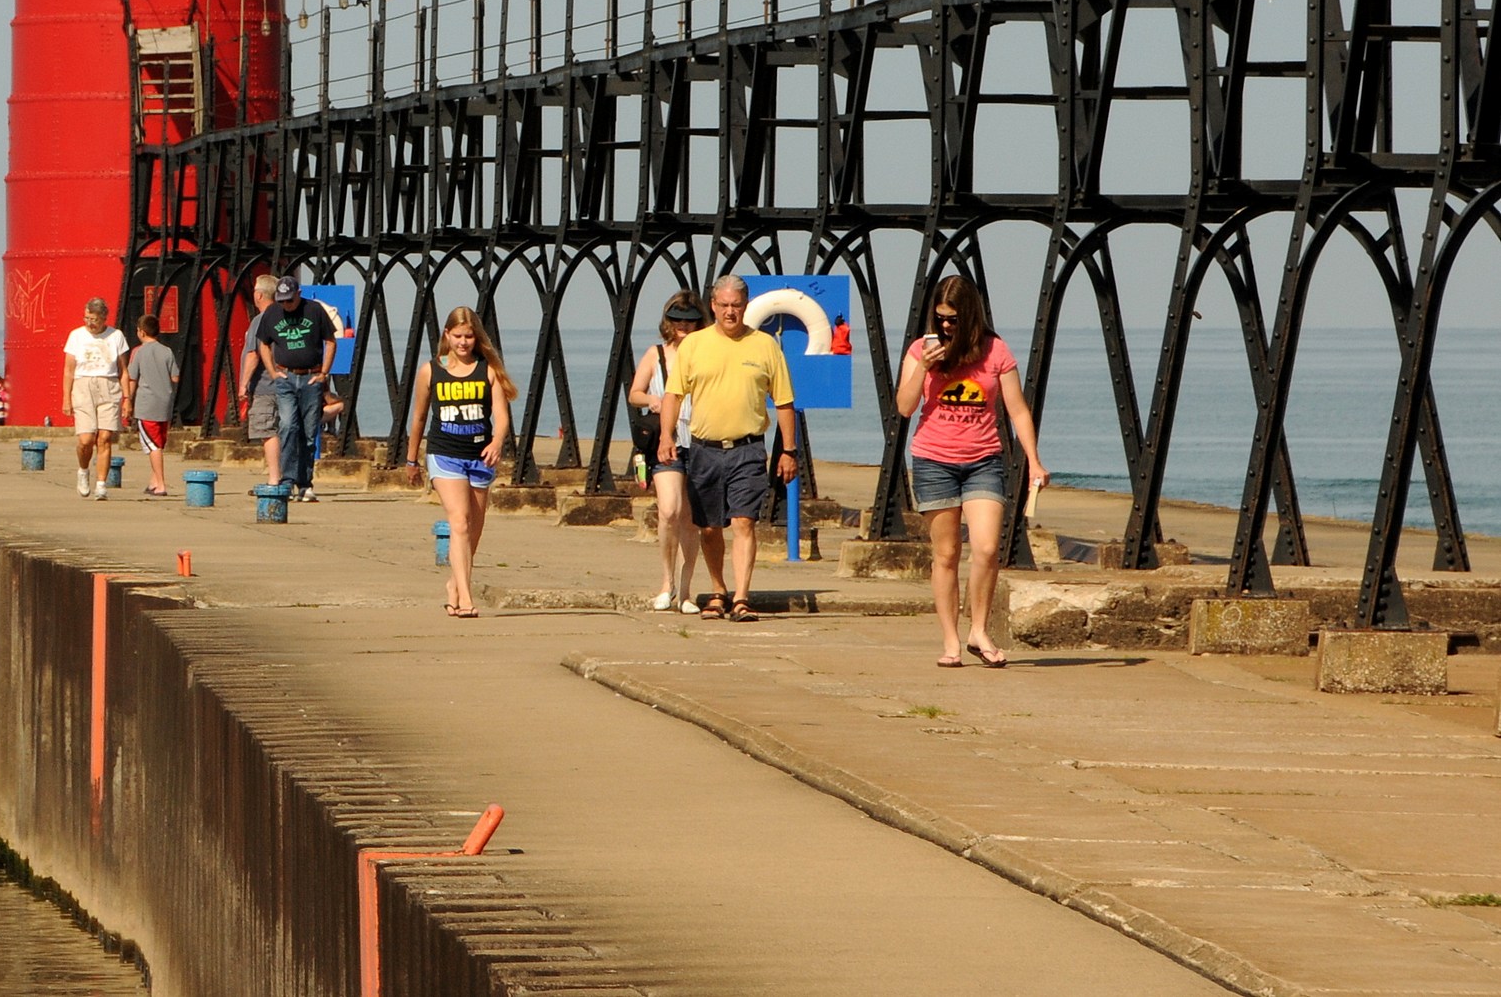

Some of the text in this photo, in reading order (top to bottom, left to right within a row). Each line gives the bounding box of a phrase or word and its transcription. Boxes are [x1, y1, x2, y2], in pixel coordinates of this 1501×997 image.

[436, 381, 486, 401] LIGHT
[440, 403, 485, 422] UP THE
[938, 413, 983, 424] MATATA
